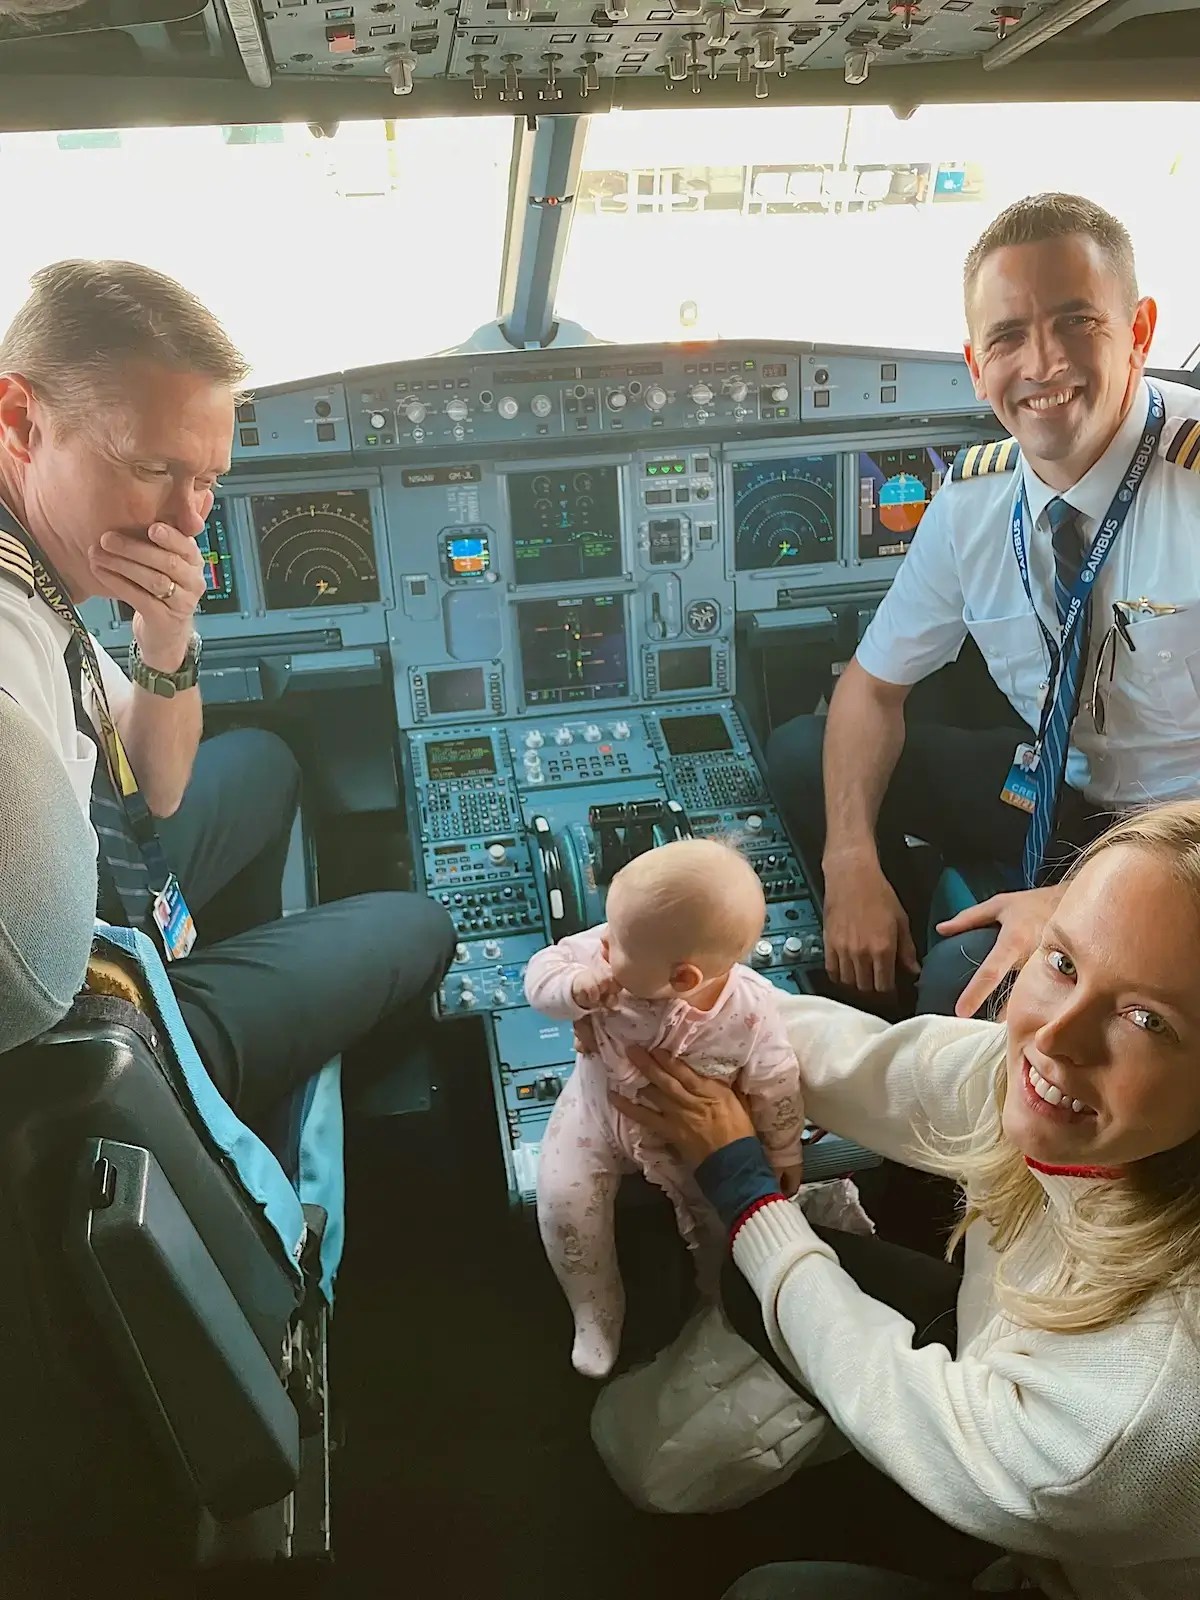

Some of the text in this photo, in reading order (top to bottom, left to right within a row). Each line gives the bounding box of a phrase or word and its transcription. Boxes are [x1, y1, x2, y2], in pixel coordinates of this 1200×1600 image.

[1125, 434, 1156, 492] AIRBUS
[1014, 518, 1026, 569] AIRBUS
[1087, 519, 1118, 573] AIRBUS
[1012, 783, 1036, 801] CRE
